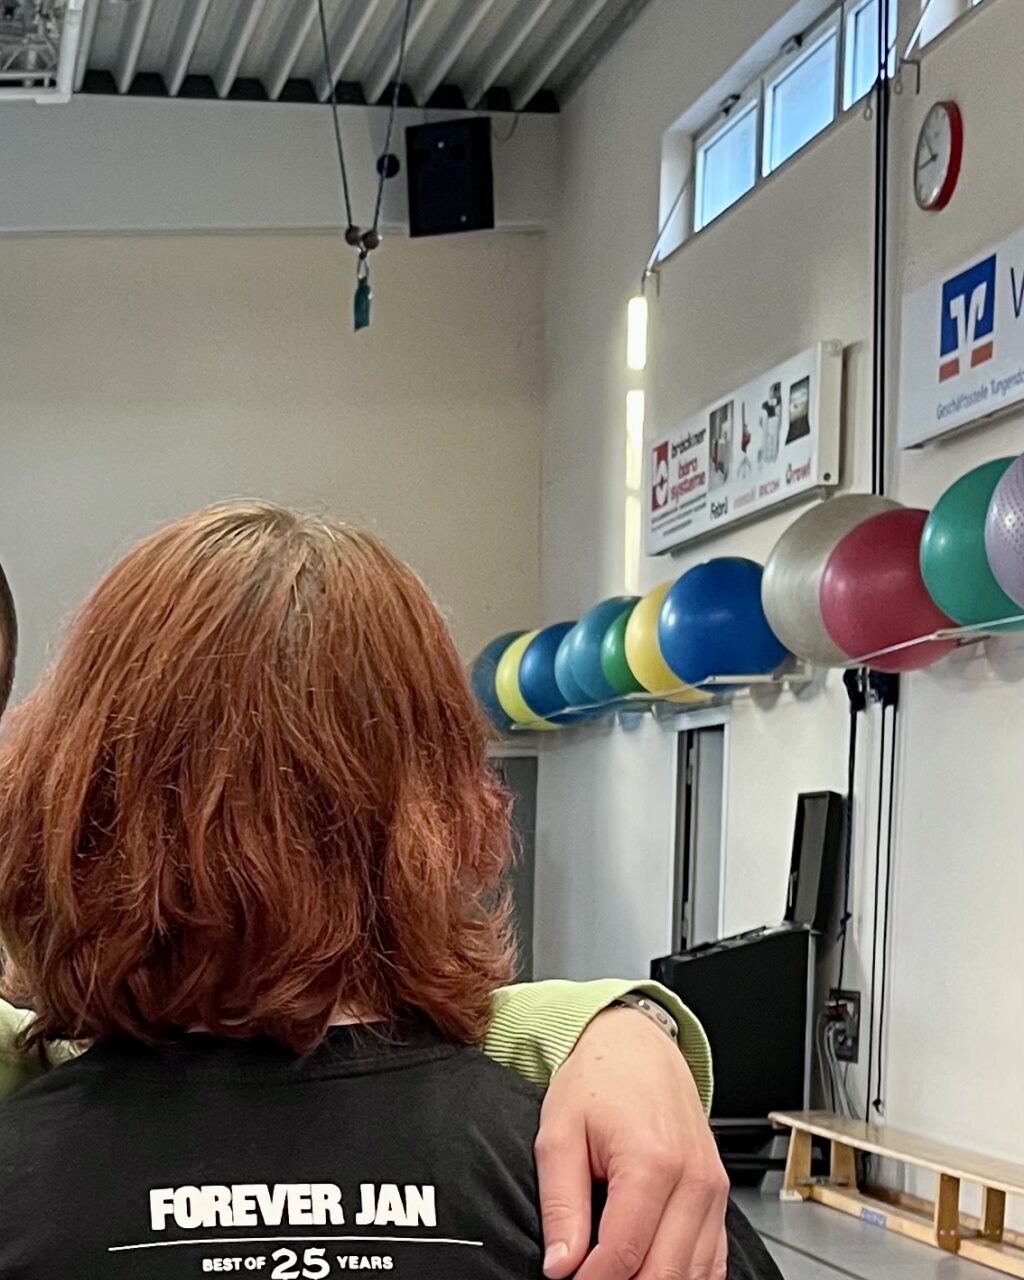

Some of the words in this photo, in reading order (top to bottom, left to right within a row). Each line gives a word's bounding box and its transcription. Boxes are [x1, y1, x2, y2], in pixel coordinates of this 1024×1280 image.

[150, 1184, 345, 1230] FOREVER
[355, 1183, 437, 1227] JAN
[202, 1257, 243, 1272] BEST
[243, 1255, 267, 1271] OF
[270, 1247, 331, 1280] 25
[336, 1255, 394, 1270] YEARS
